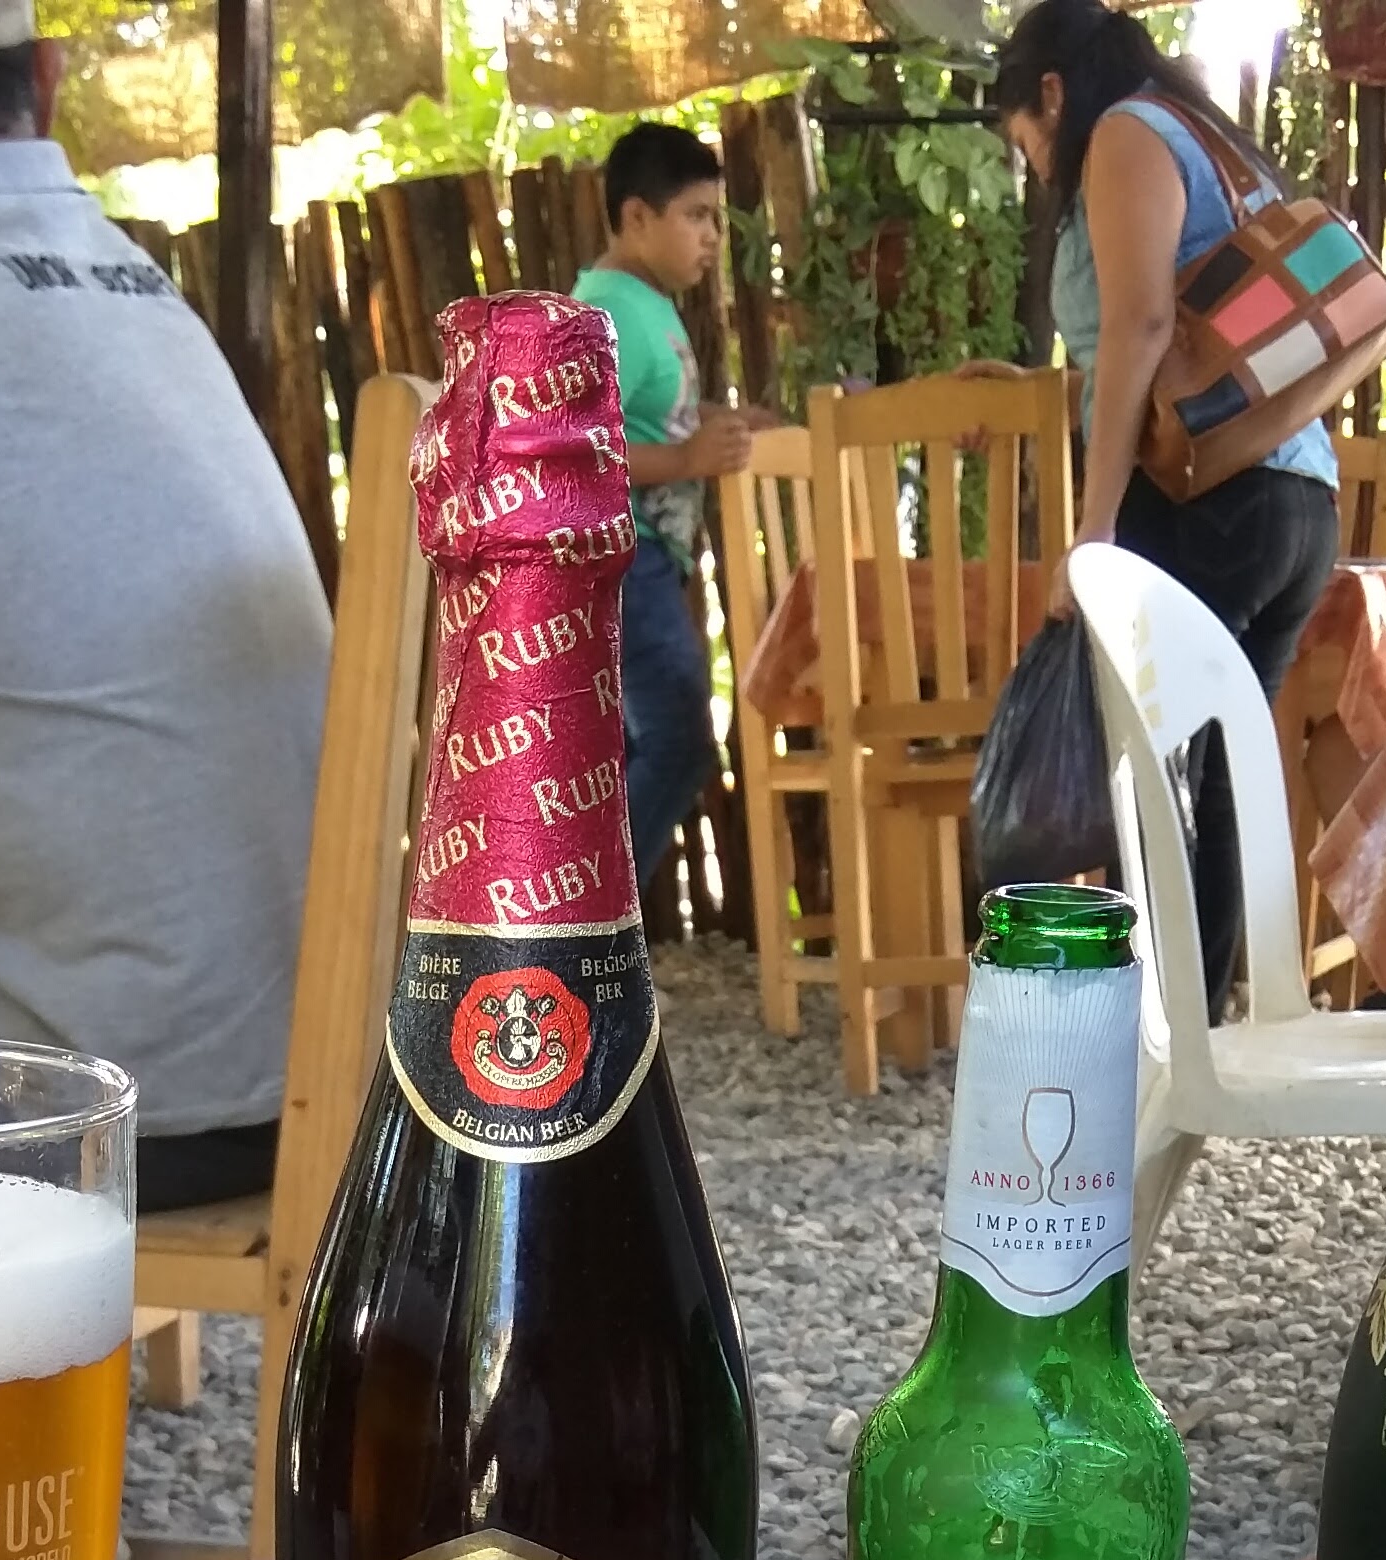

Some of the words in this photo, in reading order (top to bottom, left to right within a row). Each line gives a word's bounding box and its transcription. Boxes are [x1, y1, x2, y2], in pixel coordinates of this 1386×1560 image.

[490, 353, 603, 428] RUBY
[441, 460, 547, 547] RUBY
[546, 512, 636, 567] RUB
[477, 600, 595, 681] RUBY
[446, 702, 556, 782] RUBY
[485, 851, 604, 926] RUBY
[418, 953, 462, 977] BIÈRE
[407, 979, 451, 1001] BELGE
[451, 1108, 534, 1143] BELGIAN
[541, 1112, 588, 1140] BEER
[970, 1170, 1031, 1192] ANNO
[1063, 1171, 1116, 1192] 1366
[975, 1212, 1108, 1234] IMPORTED
[992, 1237, 1045, 1251] LAGER
[1054, 1238, 1094, 1251] BEER
